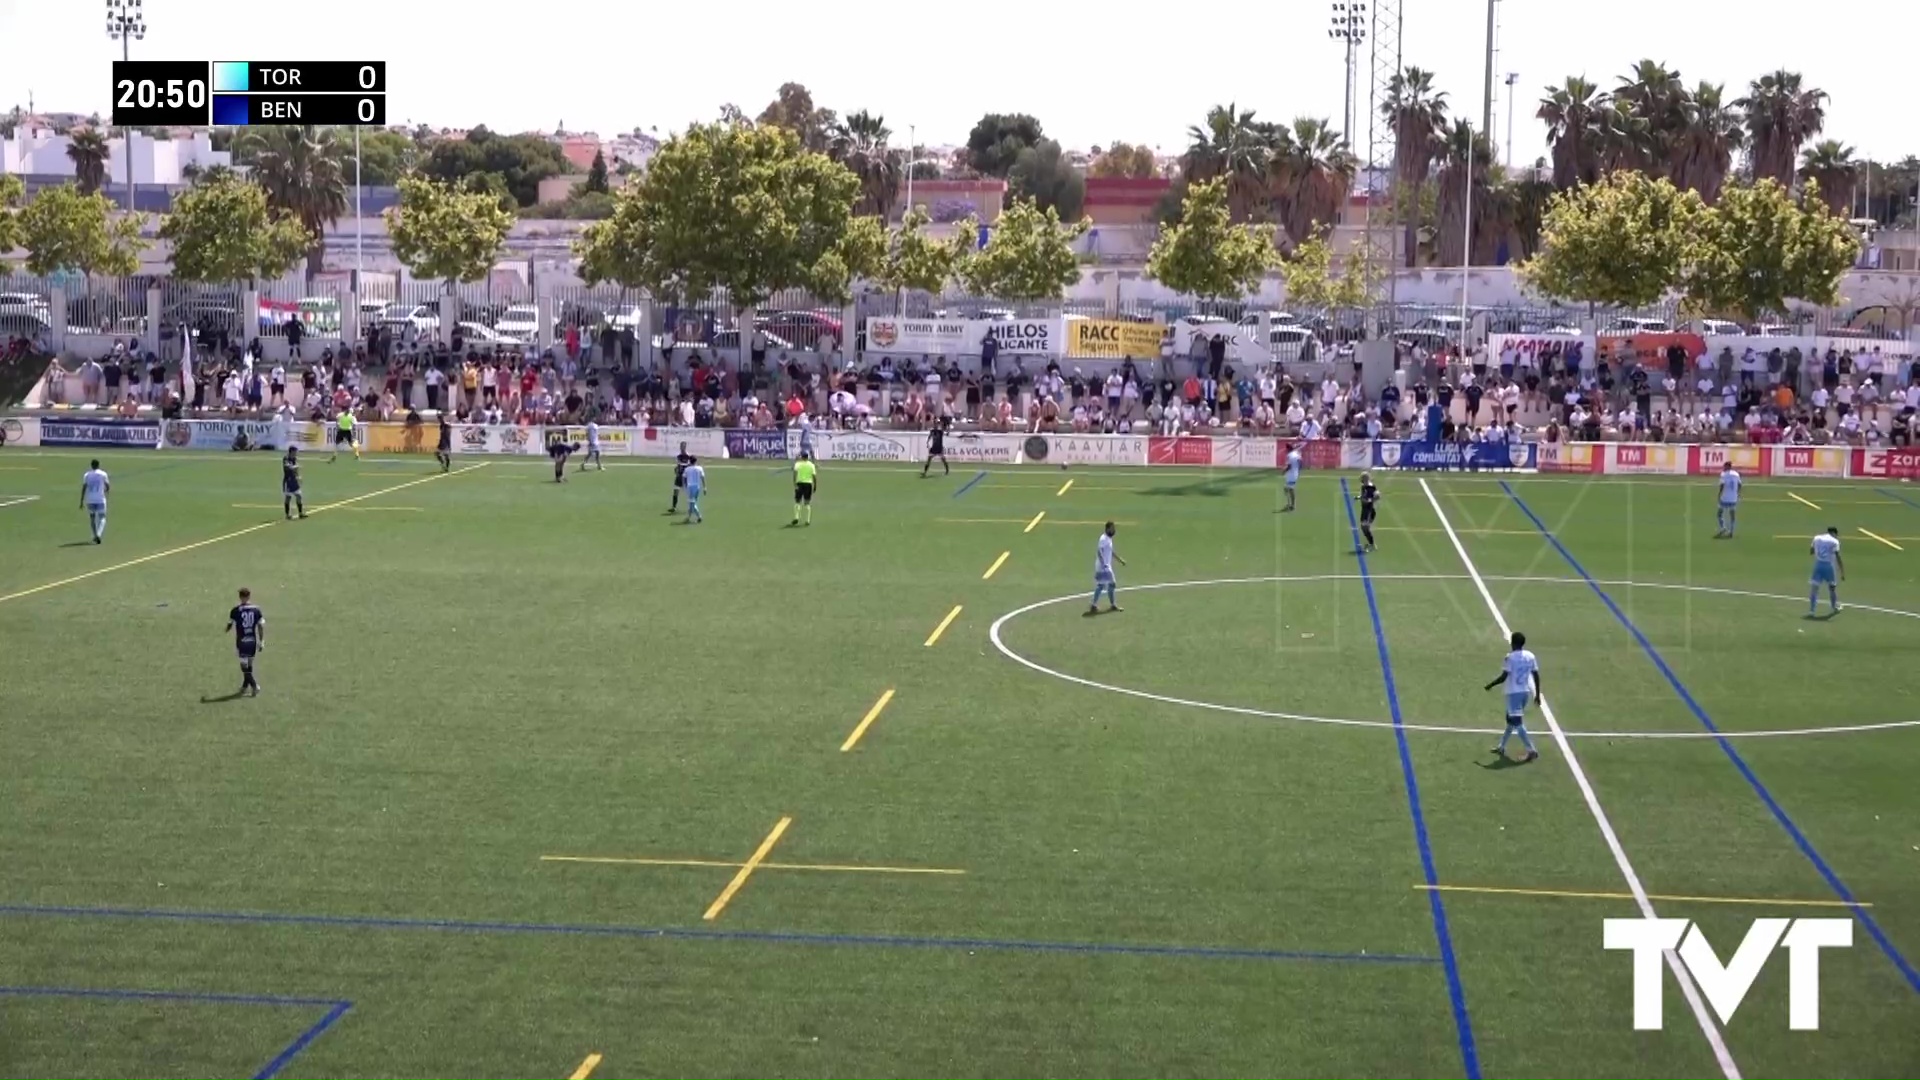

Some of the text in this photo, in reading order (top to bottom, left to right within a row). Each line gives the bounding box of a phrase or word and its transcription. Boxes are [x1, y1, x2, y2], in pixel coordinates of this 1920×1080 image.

[936, 324, 964, 333] ARMY
[989, 323, 1048, 339] HIELOS
[1080, 324, 1119, 341] RACC
[999, 339, 1048, 350] LICANTE
[1080, 341, 1119, 352] Seguros
[743, 438, 785, 454] Miguel
[832, 443, 898, 452] ISSOCAR
[1055, 440, 1141, 452] KAAVIAR
[1434, 443, 1460, 452] LLIGA
[1412, 452, 1462, 463] COMUNITAT
[1540, 448, 1557, 459] TM
[1620, 450, 1640, 461] TM
[1705, 451, 1723, 462] TM
[1788, 452, 1809, 464] TM
[241, 611, 255, 628] 30
